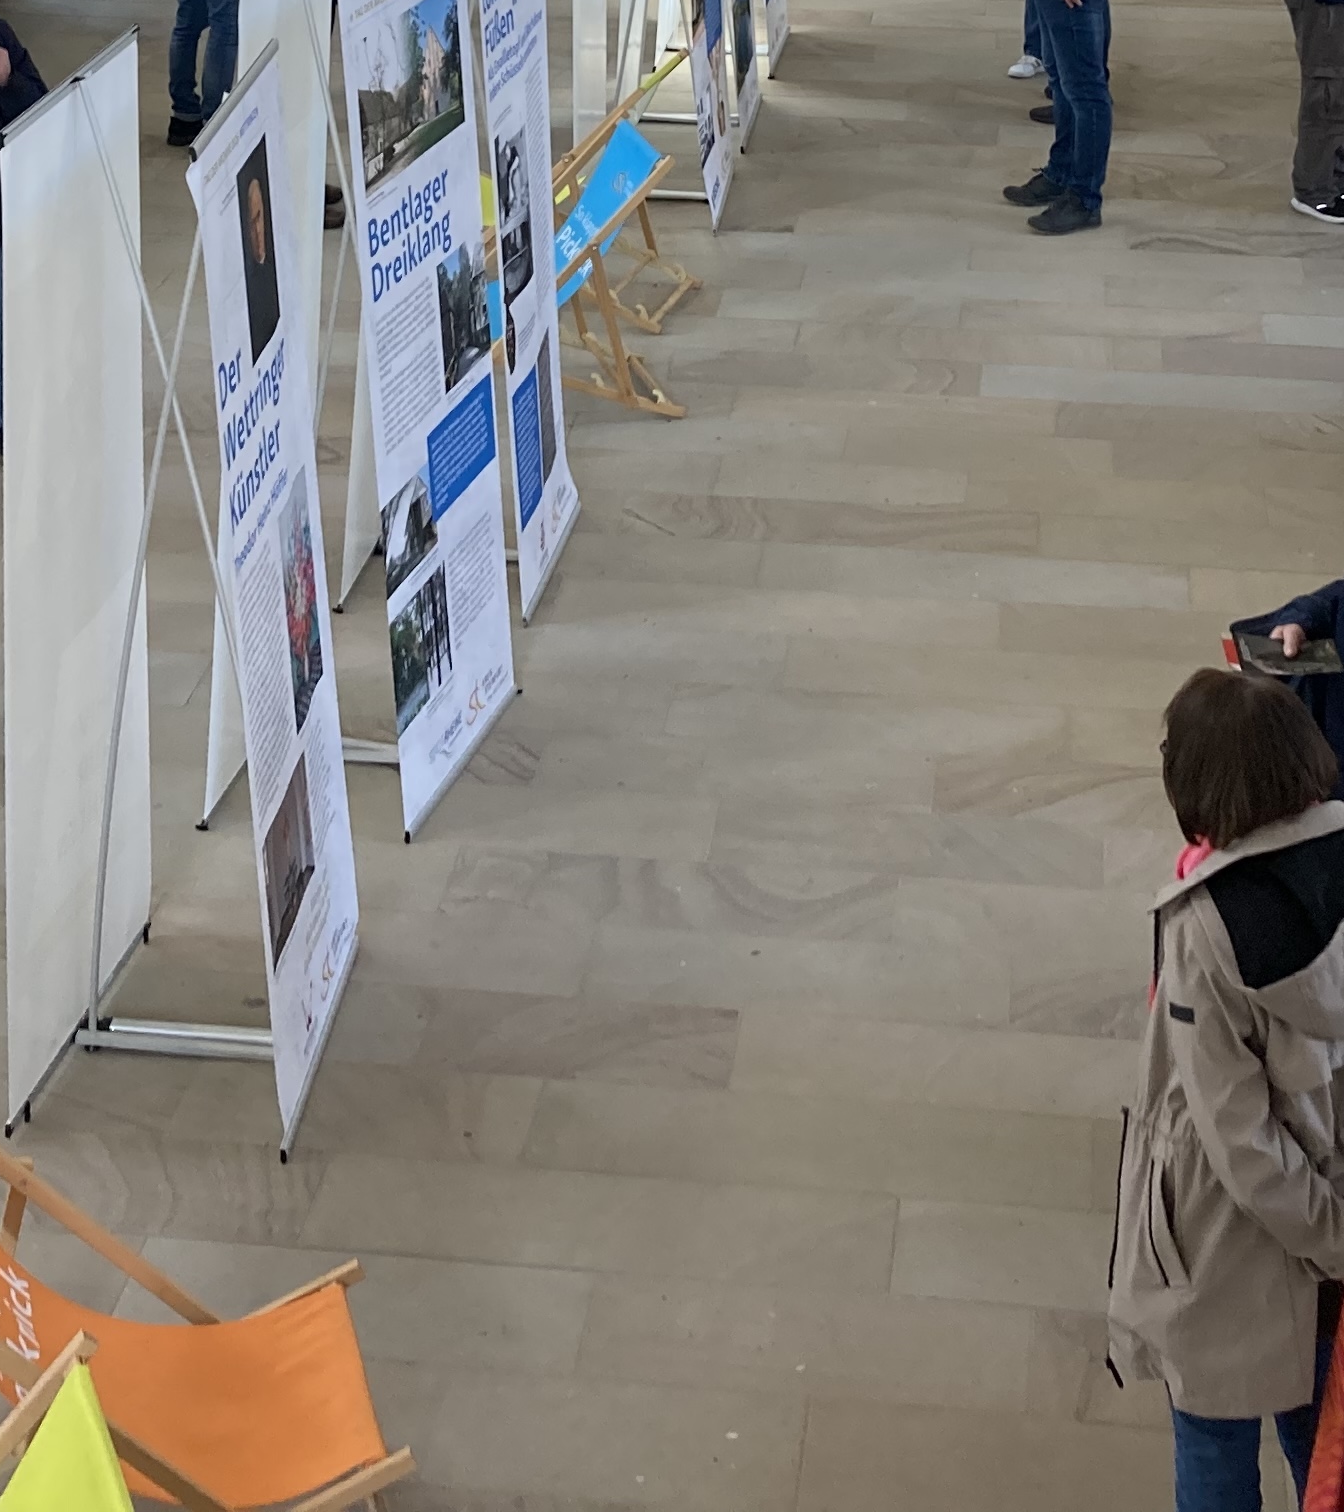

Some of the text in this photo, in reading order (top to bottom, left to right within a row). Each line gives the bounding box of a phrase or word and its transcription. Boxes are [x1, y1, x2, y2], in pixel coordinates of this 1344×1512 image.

[368, 169, 448, 258] Bentlager
[371, 210, 452, 303] Dreiklang
[218, 348, 242, 411] Der
[223, 338, 284, 470] Wettringer
[229, 419, 281, 536] Künstler
